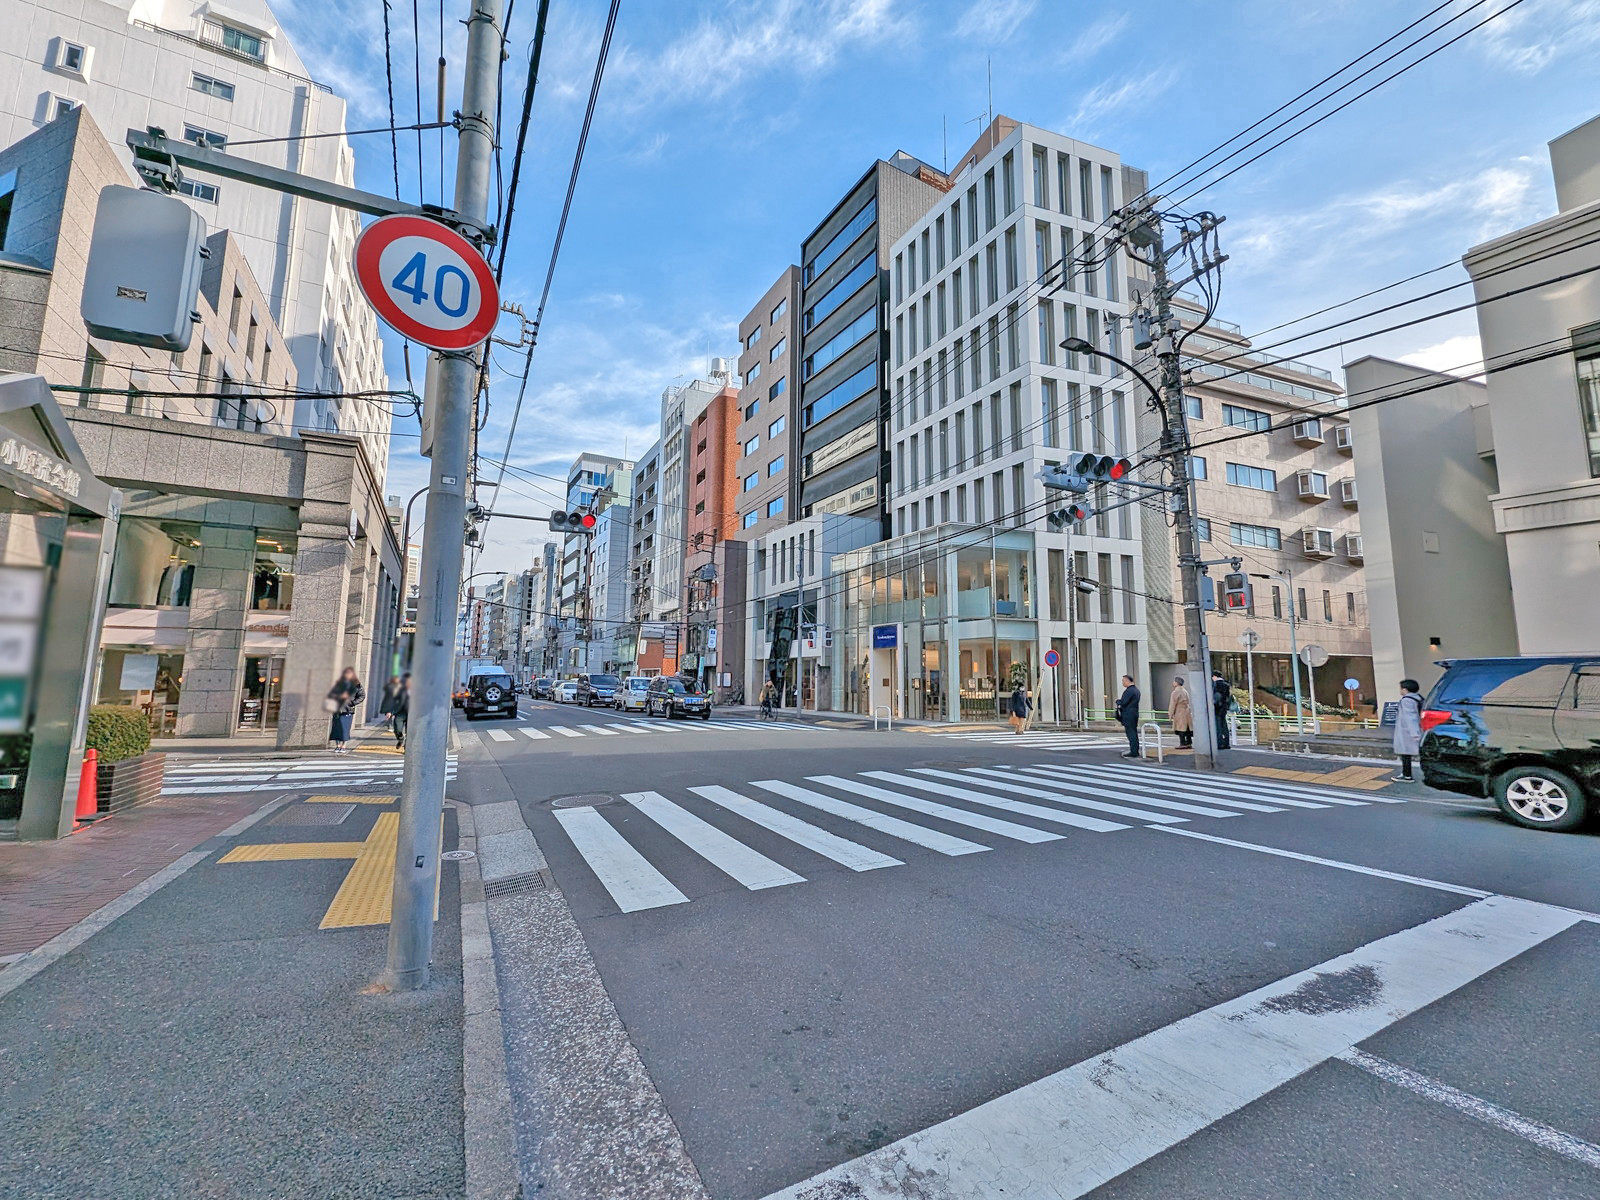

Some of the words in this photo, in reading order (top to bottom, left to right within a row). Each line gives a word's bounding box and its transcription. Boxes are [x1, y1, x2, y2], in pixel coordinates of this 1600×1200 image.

[392, 252, 470, 317] 40
[0, 438, 81, 497] 小原流会館
